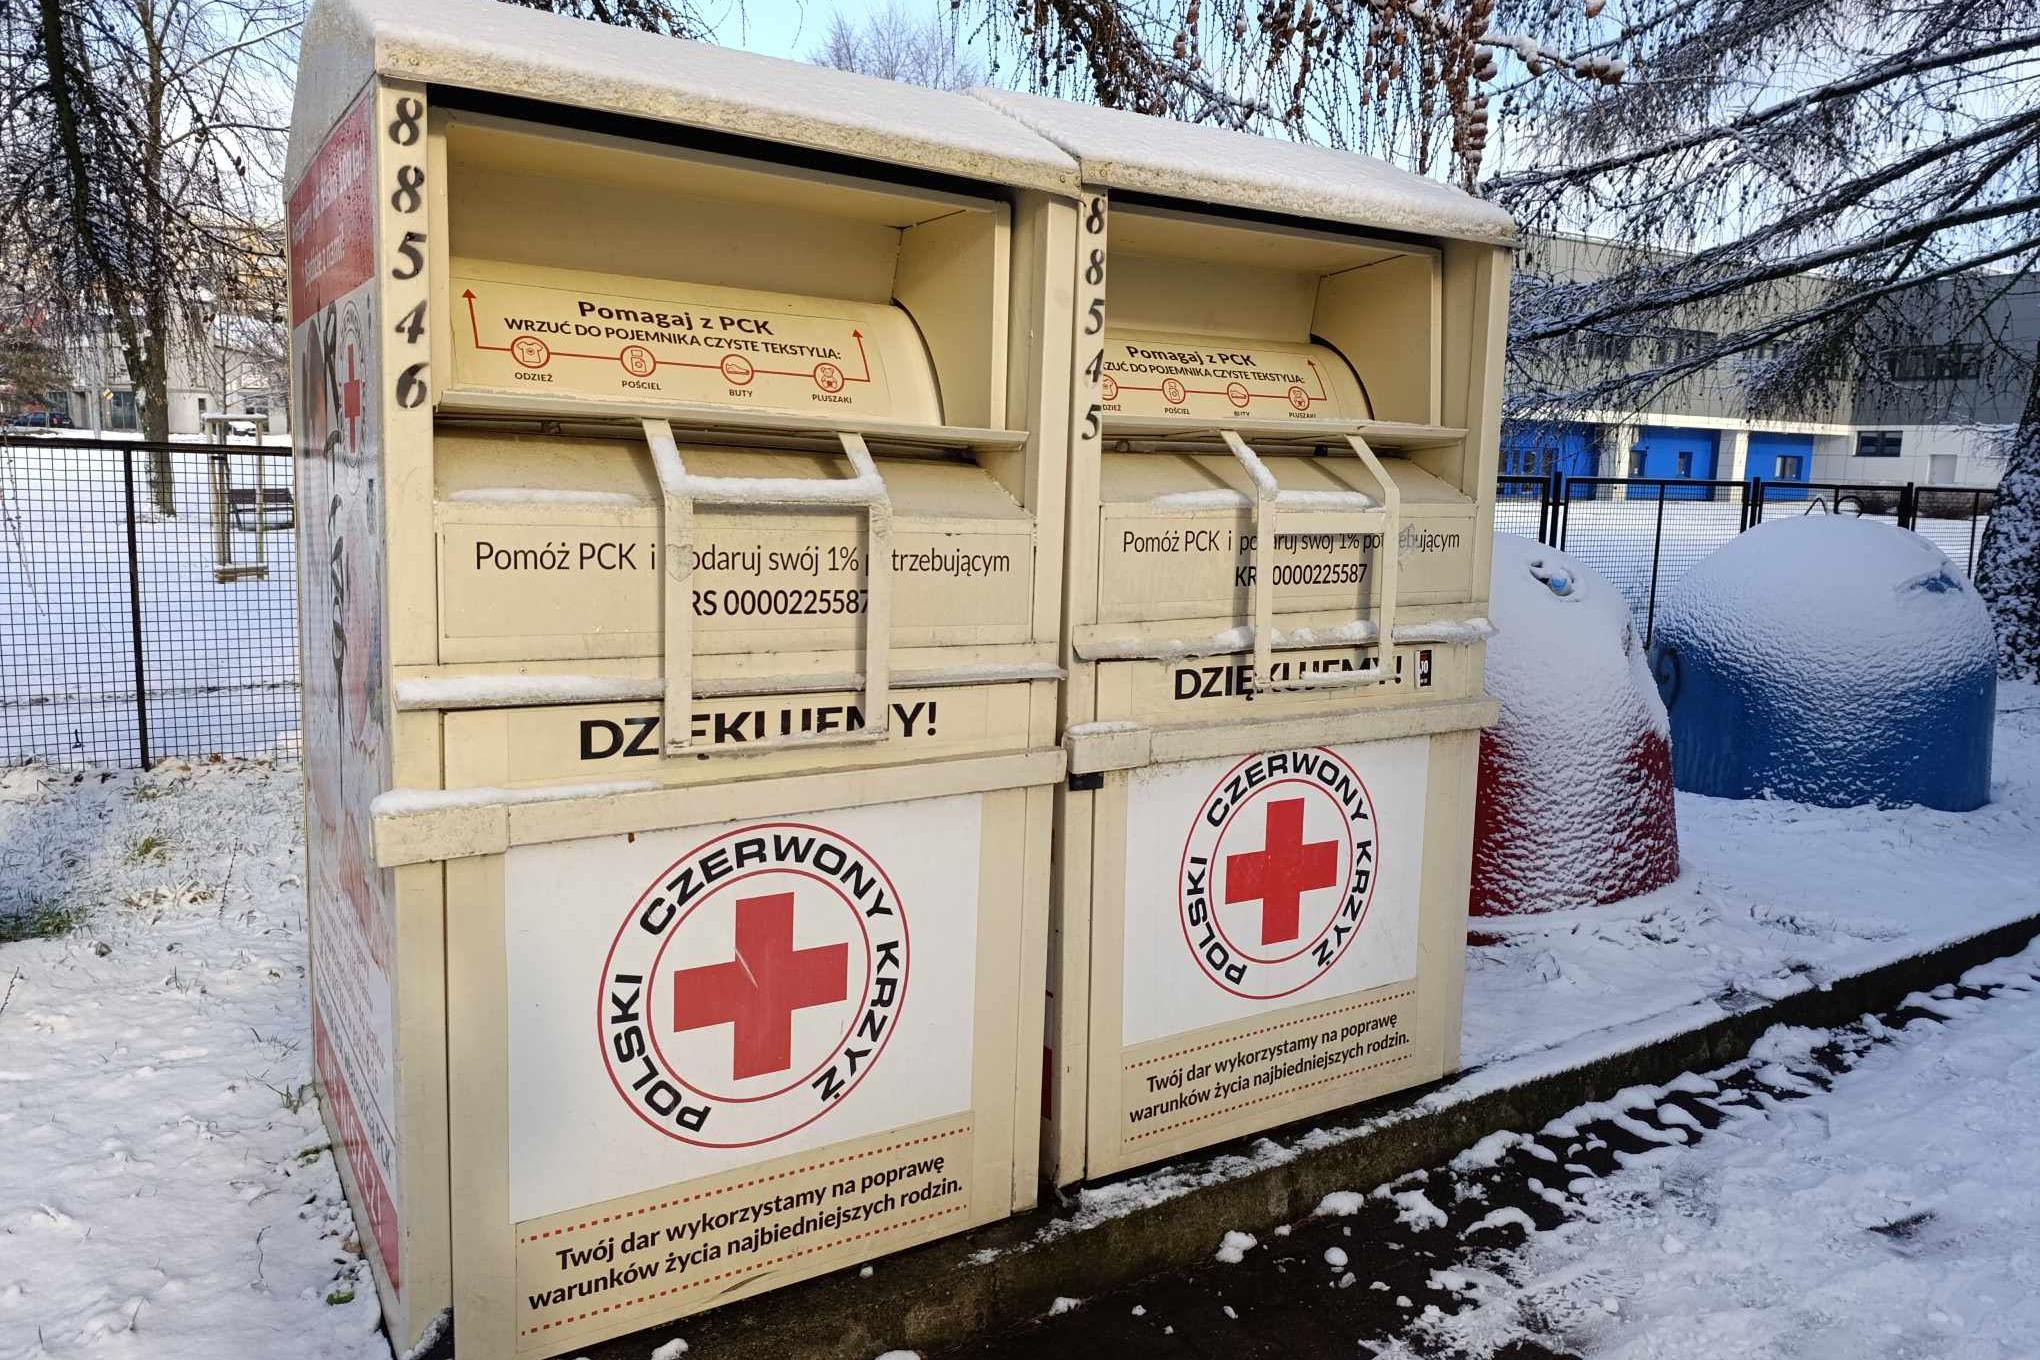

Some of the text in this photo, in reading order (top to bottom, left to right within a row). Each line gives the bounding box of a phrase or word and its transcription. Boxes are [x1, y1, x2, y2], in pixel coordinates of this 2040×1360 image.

[389, 97, 428, 409] 88546
[577, 301, 775, 336] Pomagaj z PCK
[1082, 197, 1104, 440] 88545
[504, 317, 843, 360] WRZUĆ DO POJEMNIKA CZYSTE TEKSTYLIA:
[1126, 345, 1257, 367] Pomagaj z PCK
[514, 371, 553, 383] ODZIEŻ
[621, 377, 662, 391] POŚCIEL
[1103, 361, 1305, 384] ZUĆ DO POJEMNIKA CZYSTE TEKSTYLIA:
[728, 388, 753, 399] BUTY
[811, 393, 853, 405] PLUSZAKI
[1103, 404, 1121, 412] DZIEŻ
[1164, 407, 1190, 415] POŚCIEL
[1289, 411, 1316, 419] PLUSZAKI
[1123, 529, 1180, 552] Pomóż
[1185, 530, 1220, 552] PCK
[1228, 530, 1233, 551] i
[1339, 533, 1360, 549] 1%
[476, 541, 570, 570] Pomóż
[579, 543, 637, 570] PCK
[650, 543, 656, 570] i
[768, 546, 820, 577] swój
[827, 546, 859, 571] 1%
[1235, 564, 1368, 587] KR 0000225587
[692, 589, 868, 616] RS 0000225587
[1186, 751, 1372, 985] POLSKI CZERWONY KRZYŻ
[610, 834, 900, 1133] POLSKI CZERWONY KRZYŻ
[1146, 1012, 1398, 1093] Twój dar wykorzystamy na poprawę
[1129, 1031, 1410, 1123] warunków życia najbiedniejszych rodzin.
[555, 1154, 946, 1271] Twój dar wykorzystamy na poprawę
[528, 1176, 964, 1311] warunków życia najbiedniejszych rodzin.
